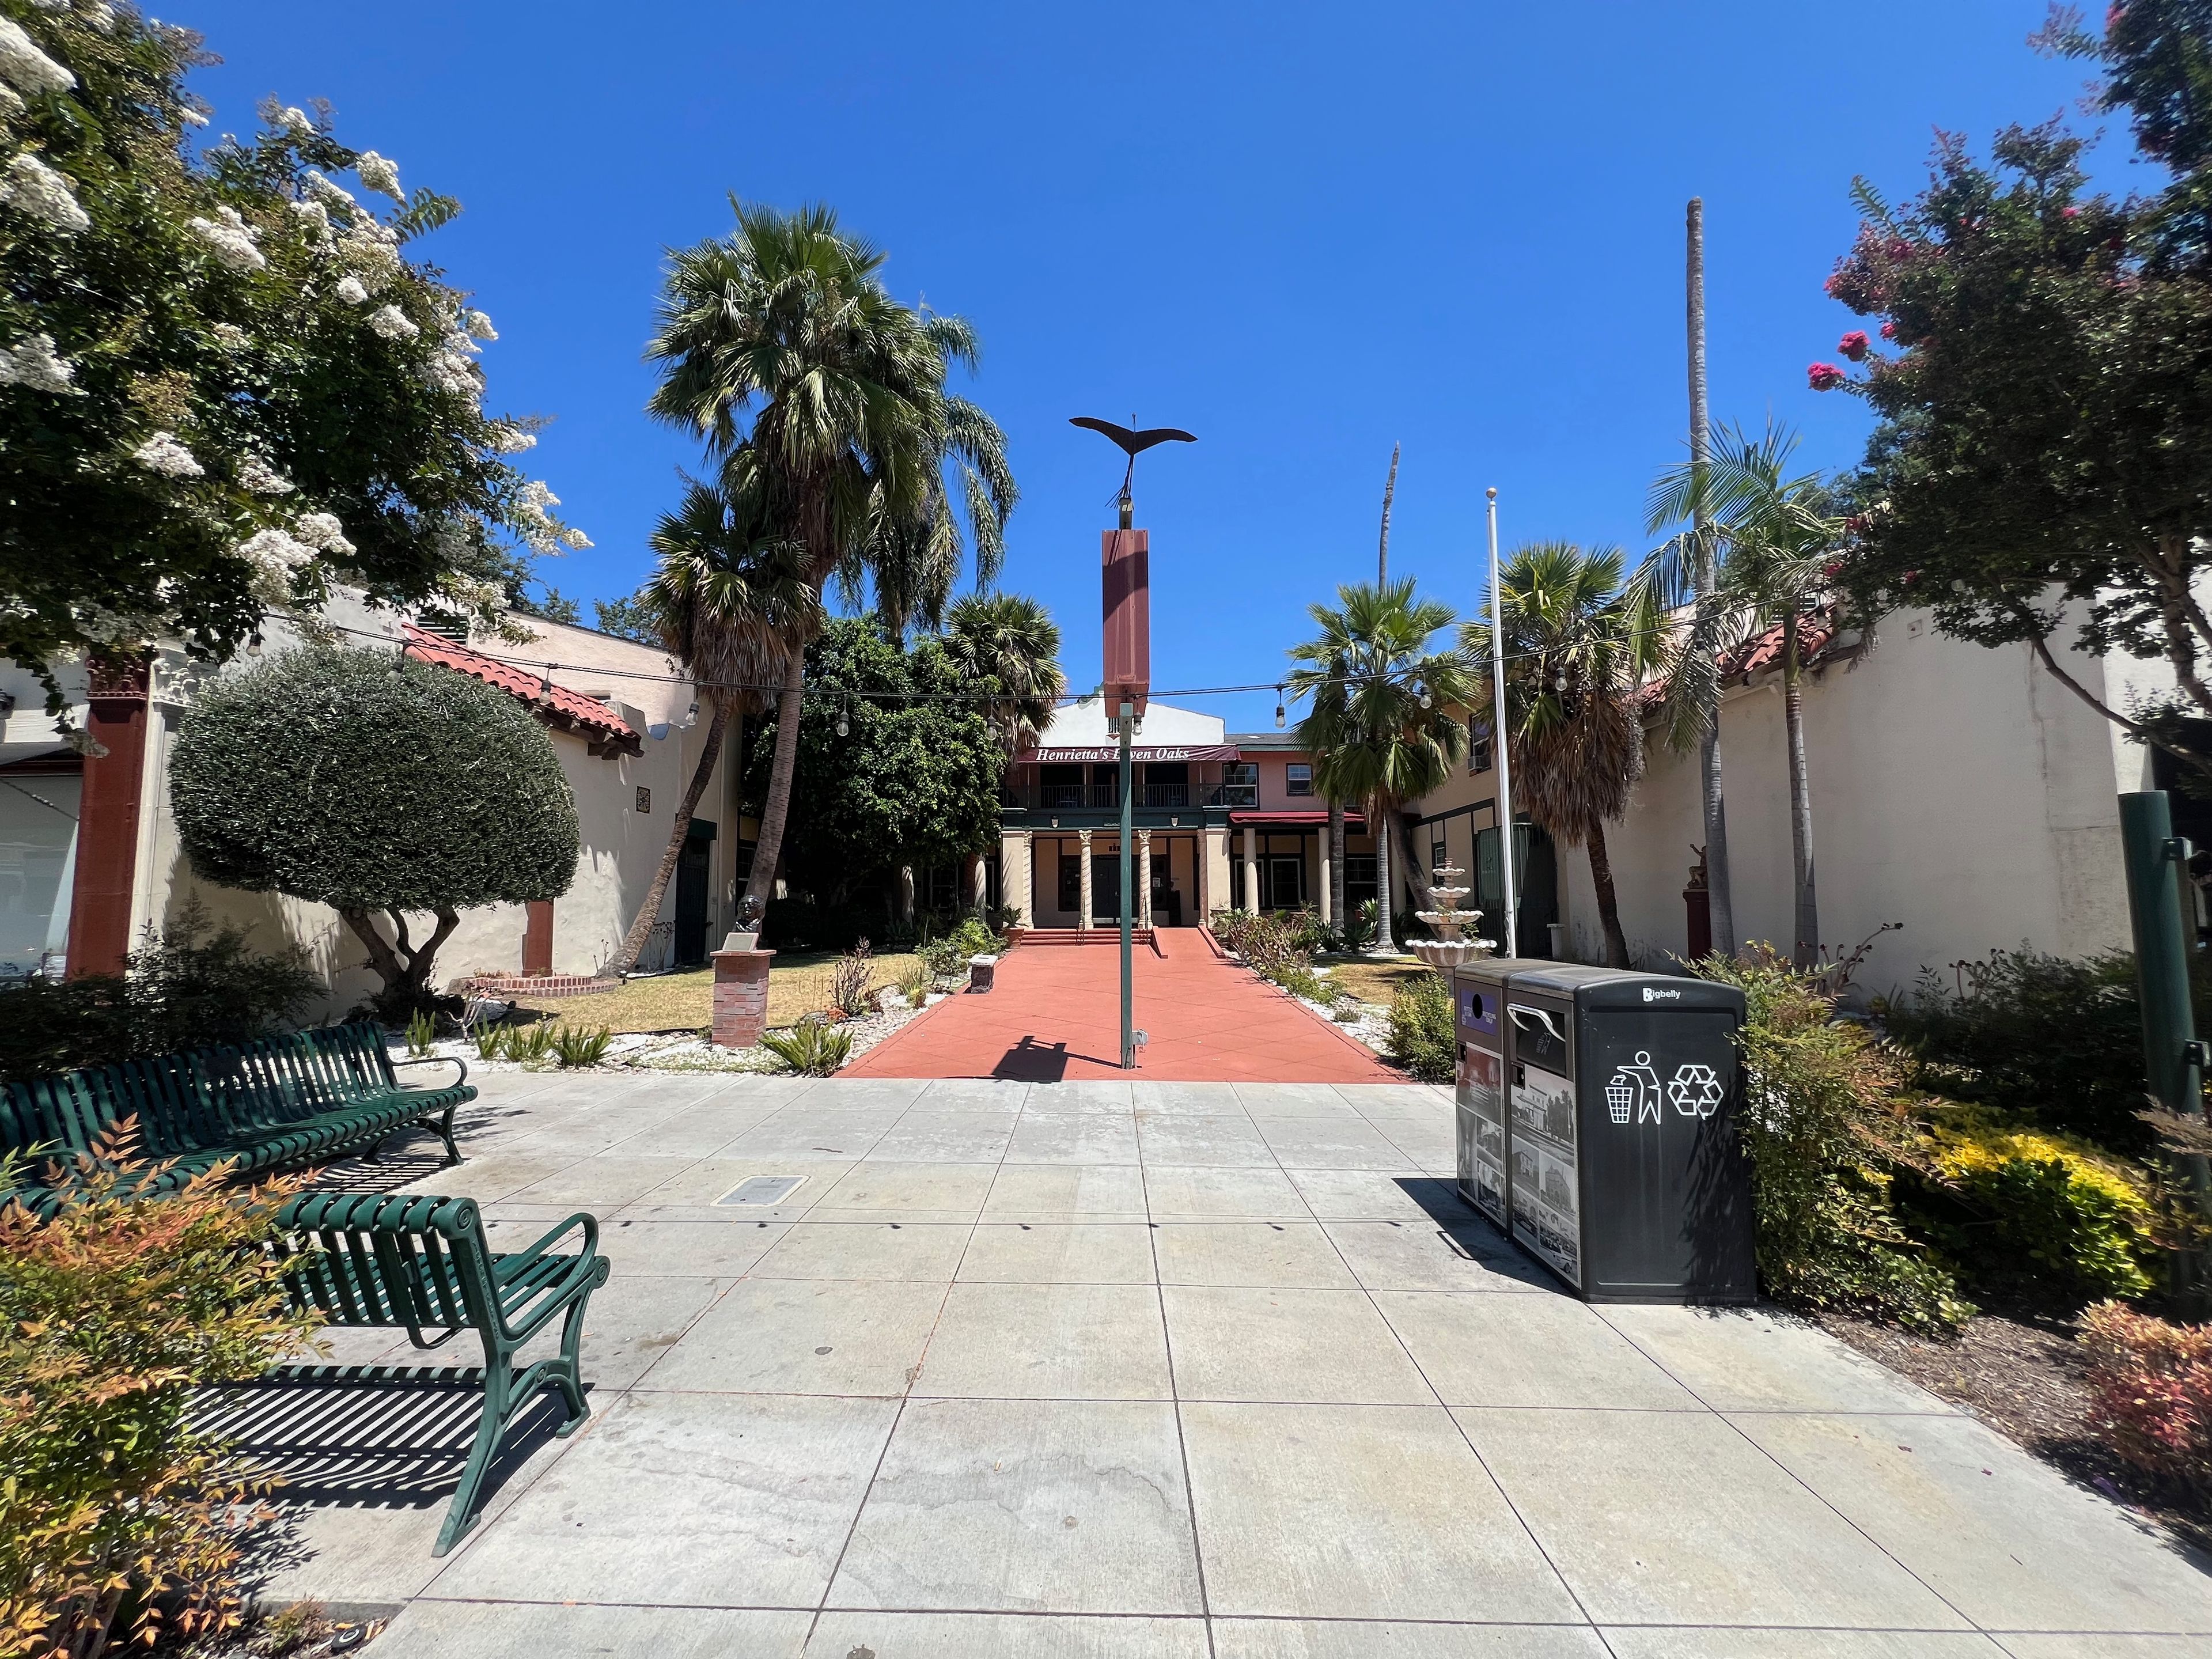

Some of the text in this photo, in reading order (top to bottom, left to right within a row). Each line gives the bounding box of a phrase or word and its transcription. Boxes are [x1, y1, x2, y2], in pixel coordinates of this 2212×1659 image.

[1036, 748, 1109, 760] Henrietta's
[1156, 747, 1190, 759] Oaks
[1642, 987, 1681, 1002] Bigbelly
